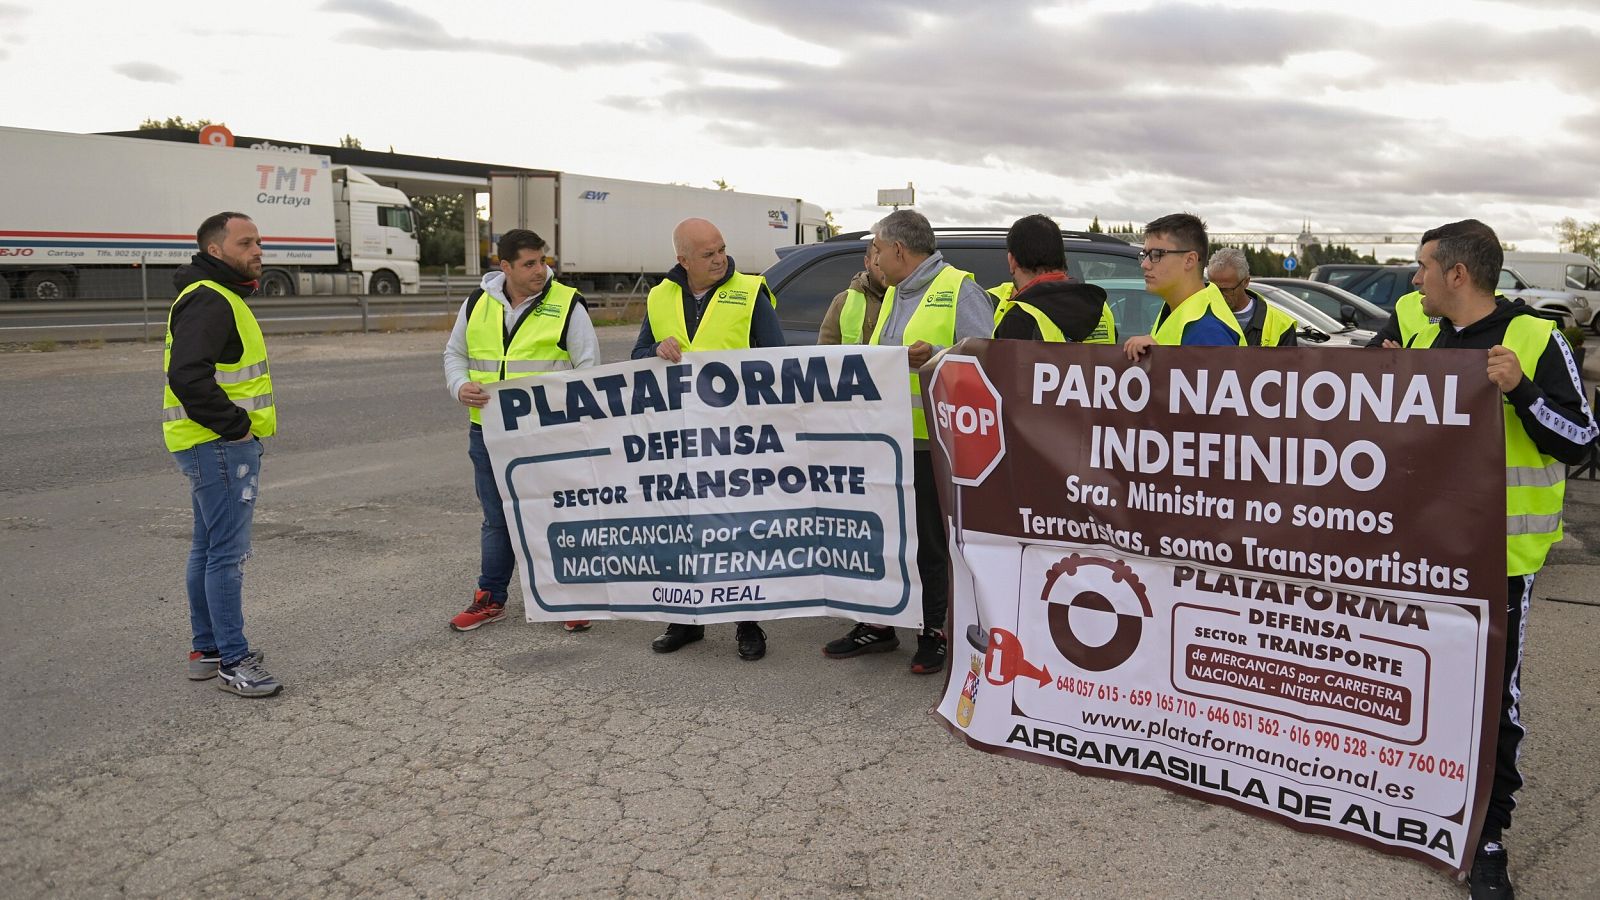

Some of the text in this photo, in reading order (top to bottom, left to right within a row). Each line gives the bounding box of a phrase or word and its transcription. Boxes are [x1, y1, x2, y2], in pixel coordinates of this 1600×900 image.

[256, 165, 318, 192] TMT
[257, 192, 311, 208] Cartaya
[585, 190, 610, 200] EWT
[47, 249, 85, 258] Cartaya
[498, 354, 882, 431] PLATAFORMA
[1032, 362, 1470, 426] PARO NACIONAL
[623, 424, 785, 463] DEFENSA
[937, 401, 995, 436] STOP
[1090, 425, 1386, 492] INDEFINIDO
[553, 465, 866, 508] SECTOR TRANSPORTE
[1065, 475, 1394, 535] Sra. Ministra no somos
[557, 516, 872, 549] de MERCANCIAS por CARRETERA
[1018, 507, 1470, 592] Terroristas, somo Transportistas
[563, 555, 661, 577] NACIONAL
[678, 546, 875, 576] INTERNACIONAL
[652, 585, 766, 605] CIUDAD REAL
[1173, 565, 1430, 631] PLATAFORMA
[1248, 607, 1352, 642] DEFENSA
[1191, 649, 1403, 703] de MERCANCIAS por CARRETERA
[1194, 626, 1403, 677] SECTOR TRANSPORTE
[1191, 664, 1266, 691] NACIONAL
[1280, 681, 1402, 722] INTERNACIONAL
[1056, 675, 1075, 693] 648
[1077, 680, 1095, 698] 057
[1098, 685, 1119, 702] 615
[1130, 690, 1151, 706] 659
[1156, 692, 1174, 711] 165
[1177, 700, 1196, 718] 710
[1207, 705, 1230, 724] 646
[1233, 710, 1253, 730] 051
[1258, 717, 1279, 737] 562
[1290, 725, 1310, 746] 616
[1315, 730, 1339, 751] 990
[1343, 737, 1367, 757] 528
[1379, 746, 1403, 767] 637
[1408, 752, 1435, 774] 760
[1439, 758, 1465, 782] 024
[1082, 711, 1416, 801] www.plataformanacional.es
[1006, 724, 1455, 860] ARGAMASILLA DE ALBA
